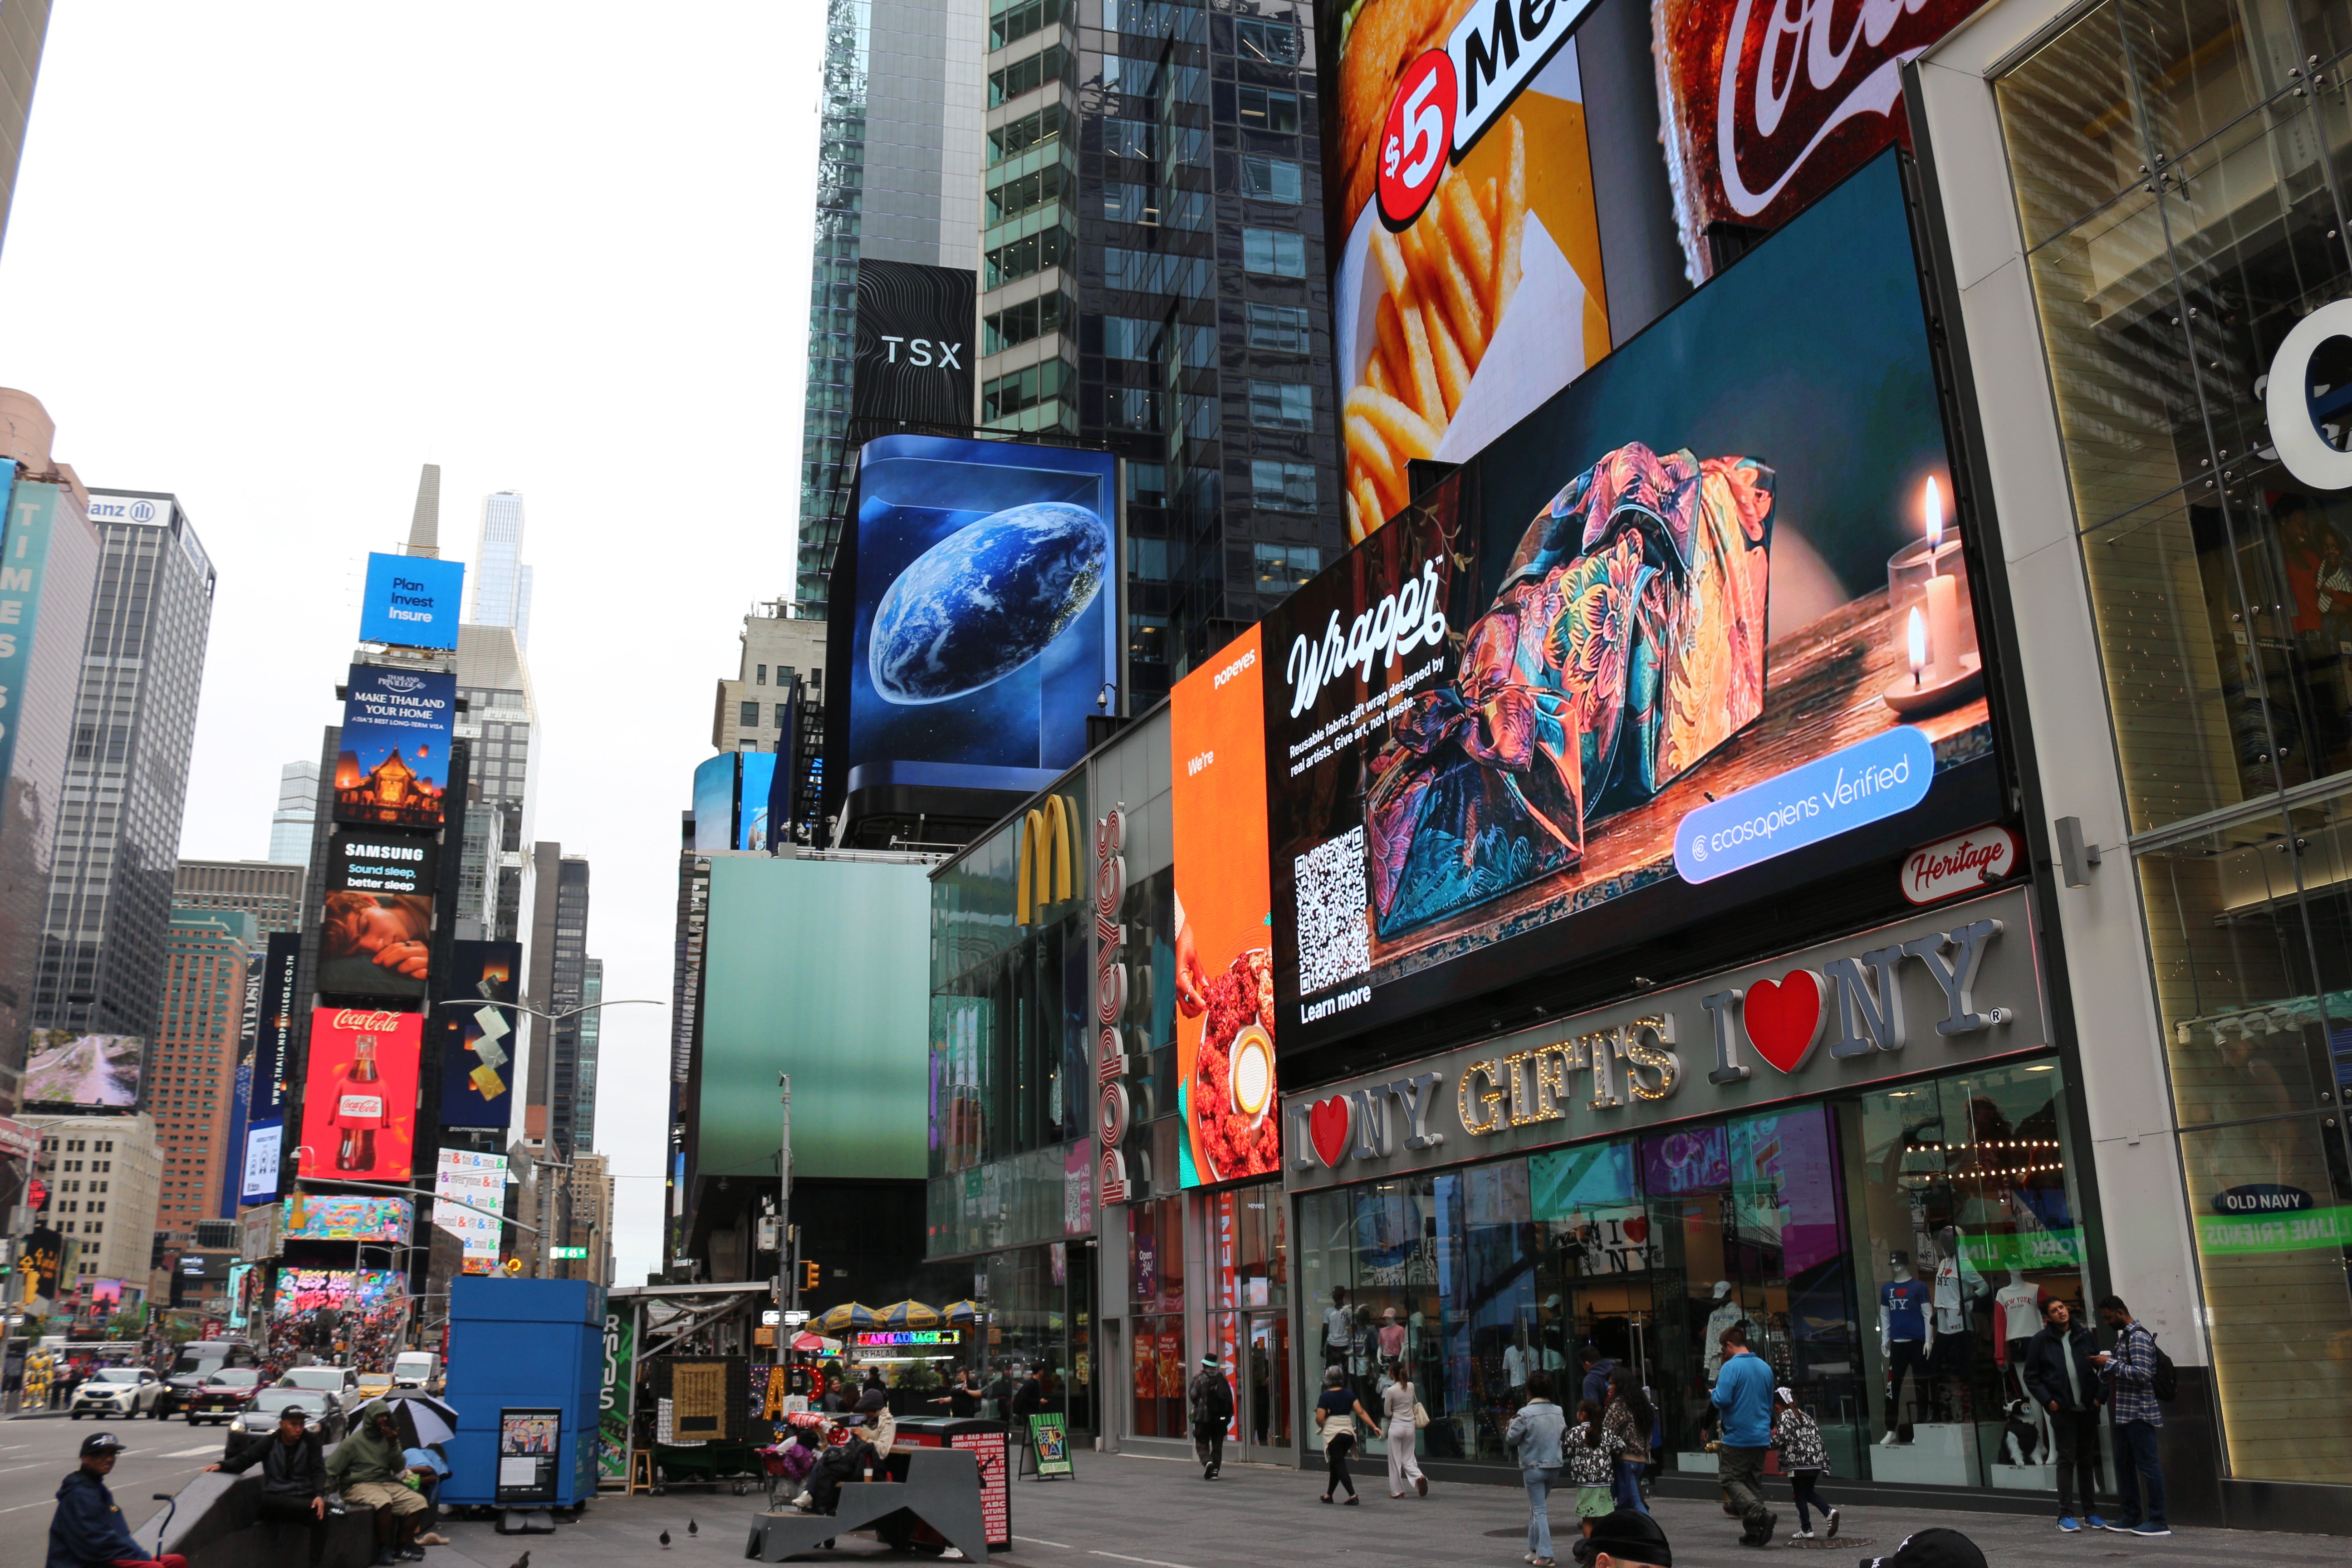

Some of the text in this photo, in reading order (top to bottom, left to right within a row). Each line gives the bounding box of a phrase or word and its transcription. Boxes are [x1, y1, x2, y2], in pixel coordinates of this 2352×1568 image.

[1384, 0, 1573, 189] $5 Me
[882, 335, 961, 370] TSX
[0, 502, 40, 659] TIMES
[393, 577, 424, 592] Plan
[391, 593, 434, 608] Invest
[388, 607, 432, 622] Insure
[354, 691, 446, 709] MAKE THAILAND
[1289, 656, 1445, 759] Reusable fabric gift wrap designed by
[365, 705, 433, 720] YOUR HOME
[389, 720, 428, 729] LONG-TERM
[1290, 696, 1416, 778] real artists. Give art, not waste.
[1188, 750, 1214, 777] We're
[1710, 754, 1908, 852] ecosapiens Verified
[345, 843, 424, 861] SAMSUNG
[348, 864, 416, 879] Sound sleep,
[1910, 840, 2004, 892] Heritage
[347, 877, 415, 892] better sleep
[1300, 985, 1372, 1024] Learn more
[1458, 1013, 1680, 1137] GIFTS
[2226, 1193, 2300, 1209] OLD NAVY
[558, 1249, 566, 1258] W
[568, 1249, 578, 1258] 45
[1139, 1250, 1152, 1262] Open
[295, 1270, 328, 1290] LESS
[2004, 1296, 2032, 1309] NEW YORK
[887, 1333, 940, 1344] SAUSAGE
[871, 1349, 895, 1358] HALAL
